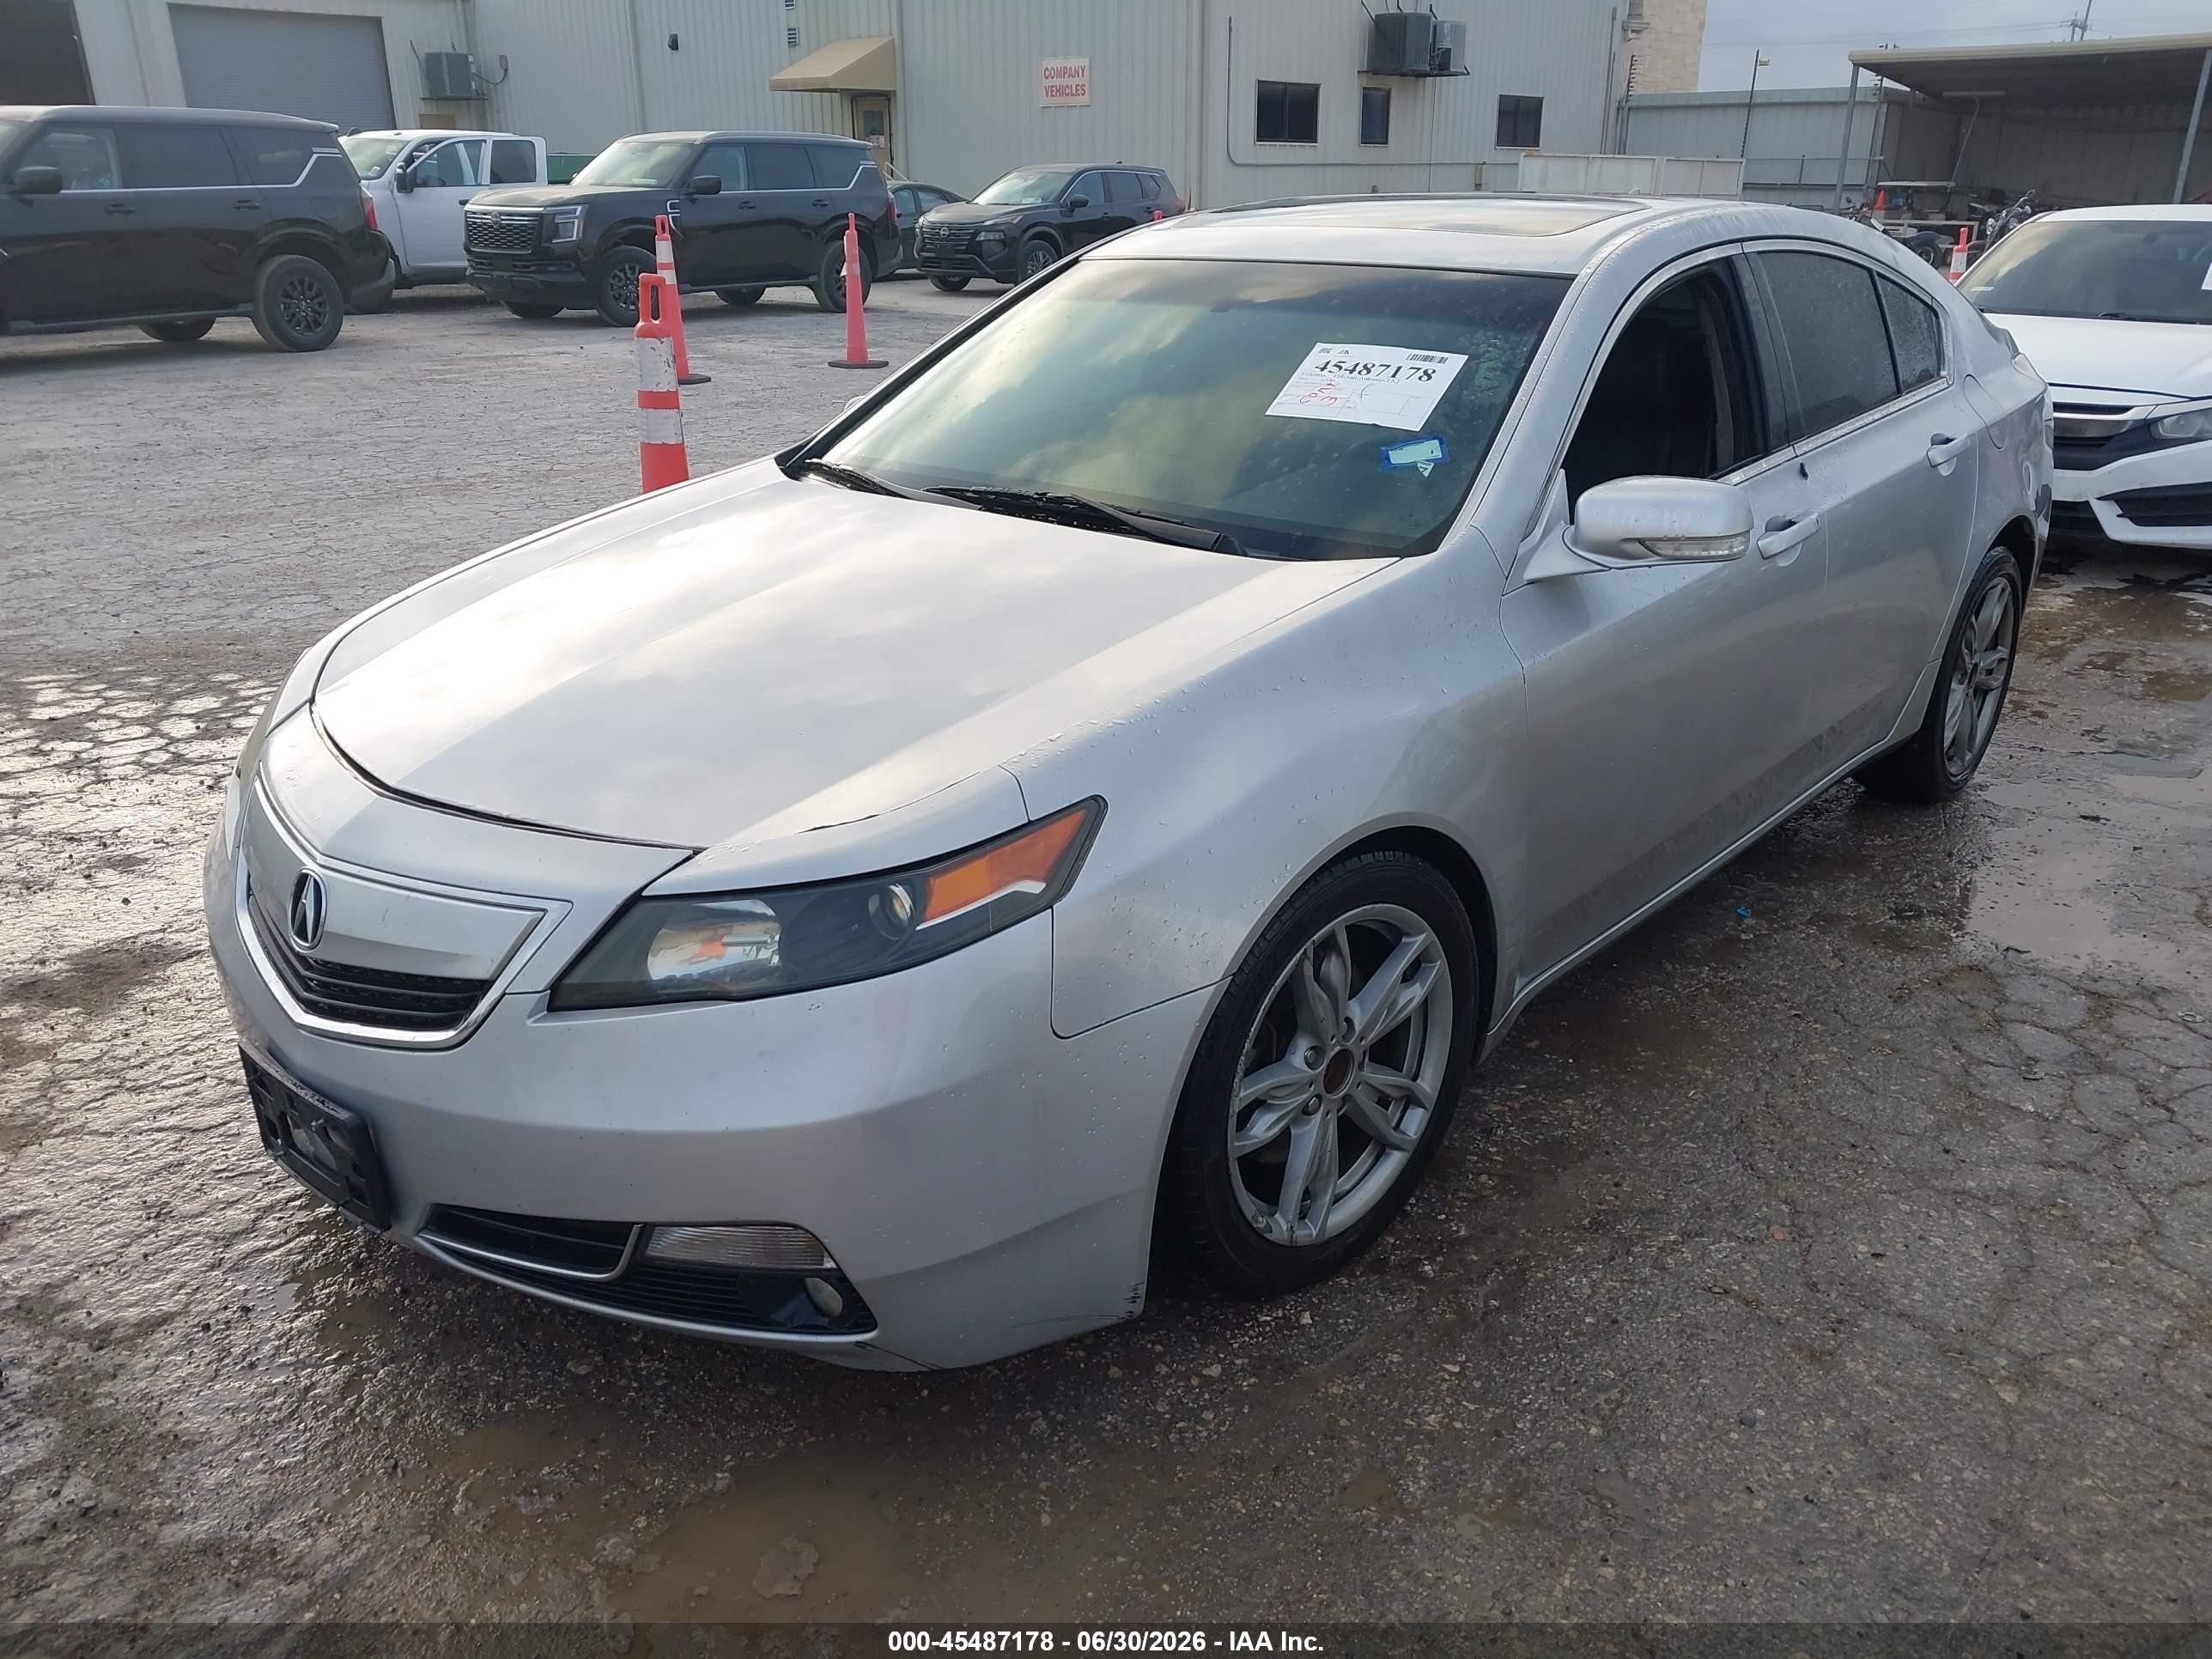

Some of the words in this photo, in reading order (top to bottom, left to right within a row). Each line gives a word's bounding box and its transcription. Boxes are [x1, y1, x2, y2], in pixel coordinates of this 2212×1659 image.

[1043, 64, 1085, 79] COMPANY
[1044, 83, 1085, 97] VEHICLES
[1315, 360, 1436, 381] 45487178
